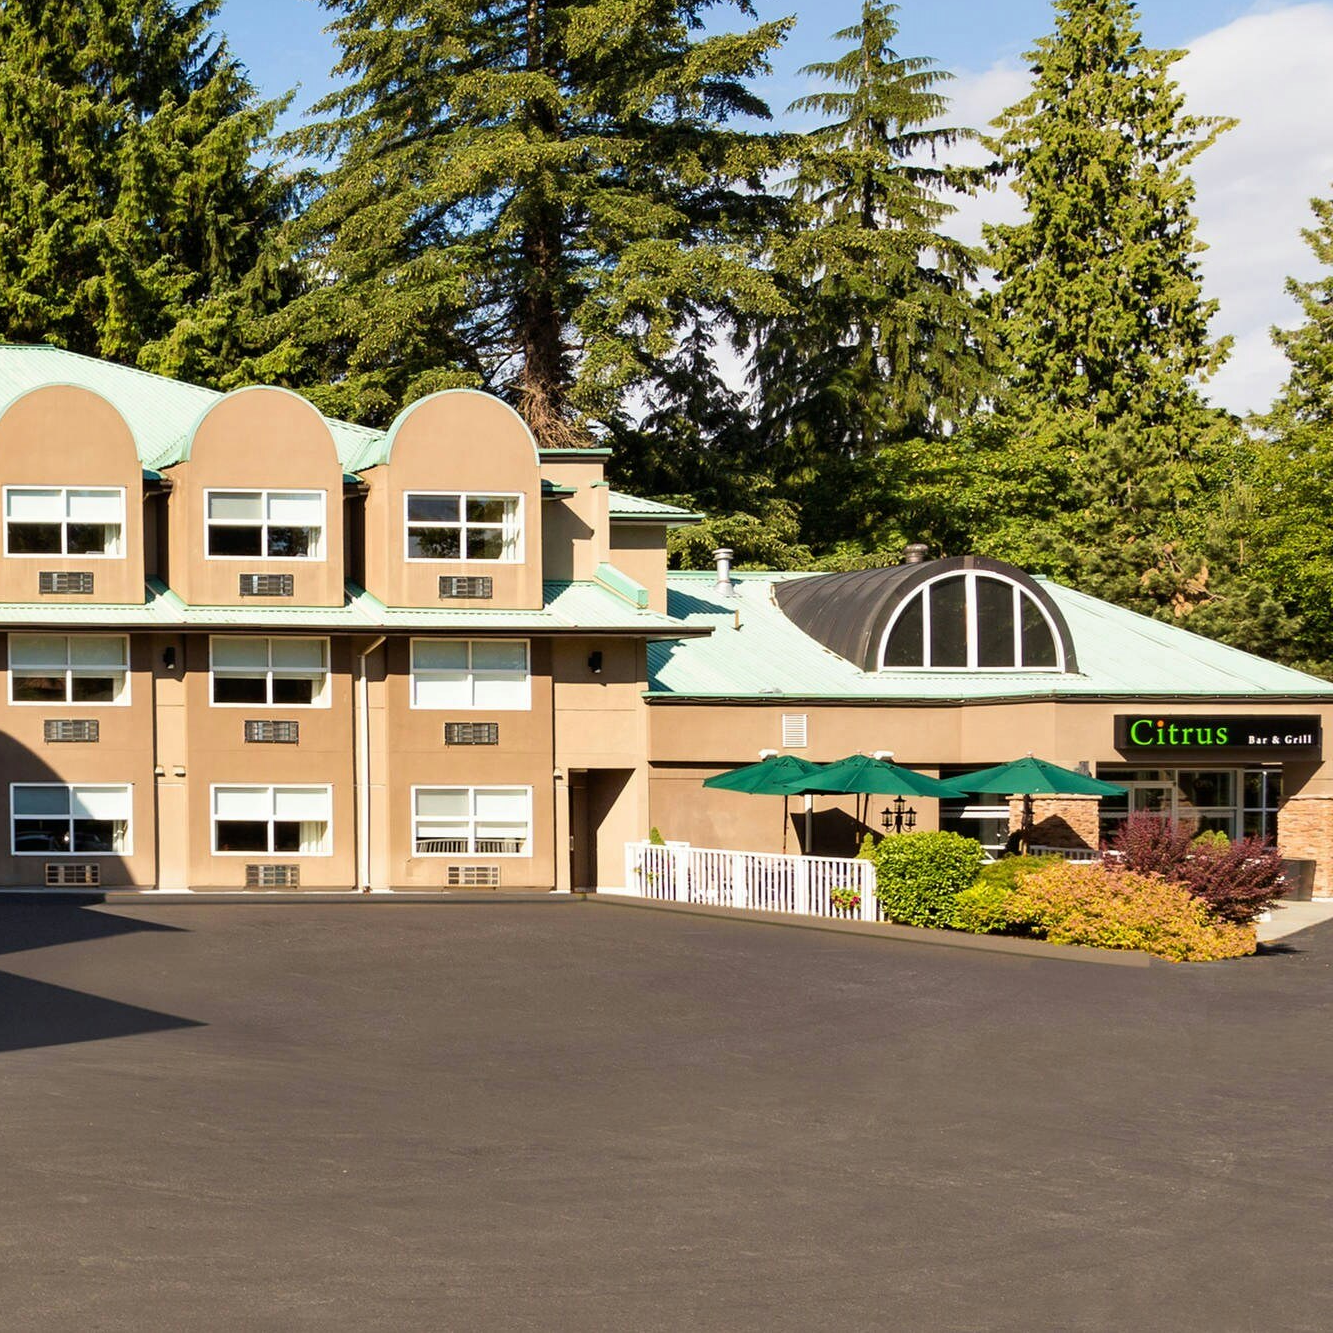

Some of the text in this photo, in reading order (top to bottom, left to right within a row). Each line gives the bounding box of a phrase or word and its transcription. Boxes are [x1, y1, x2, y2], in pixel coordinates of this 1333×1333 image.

[1130, 719, 1312, 745] Citrus Bar & Grill
